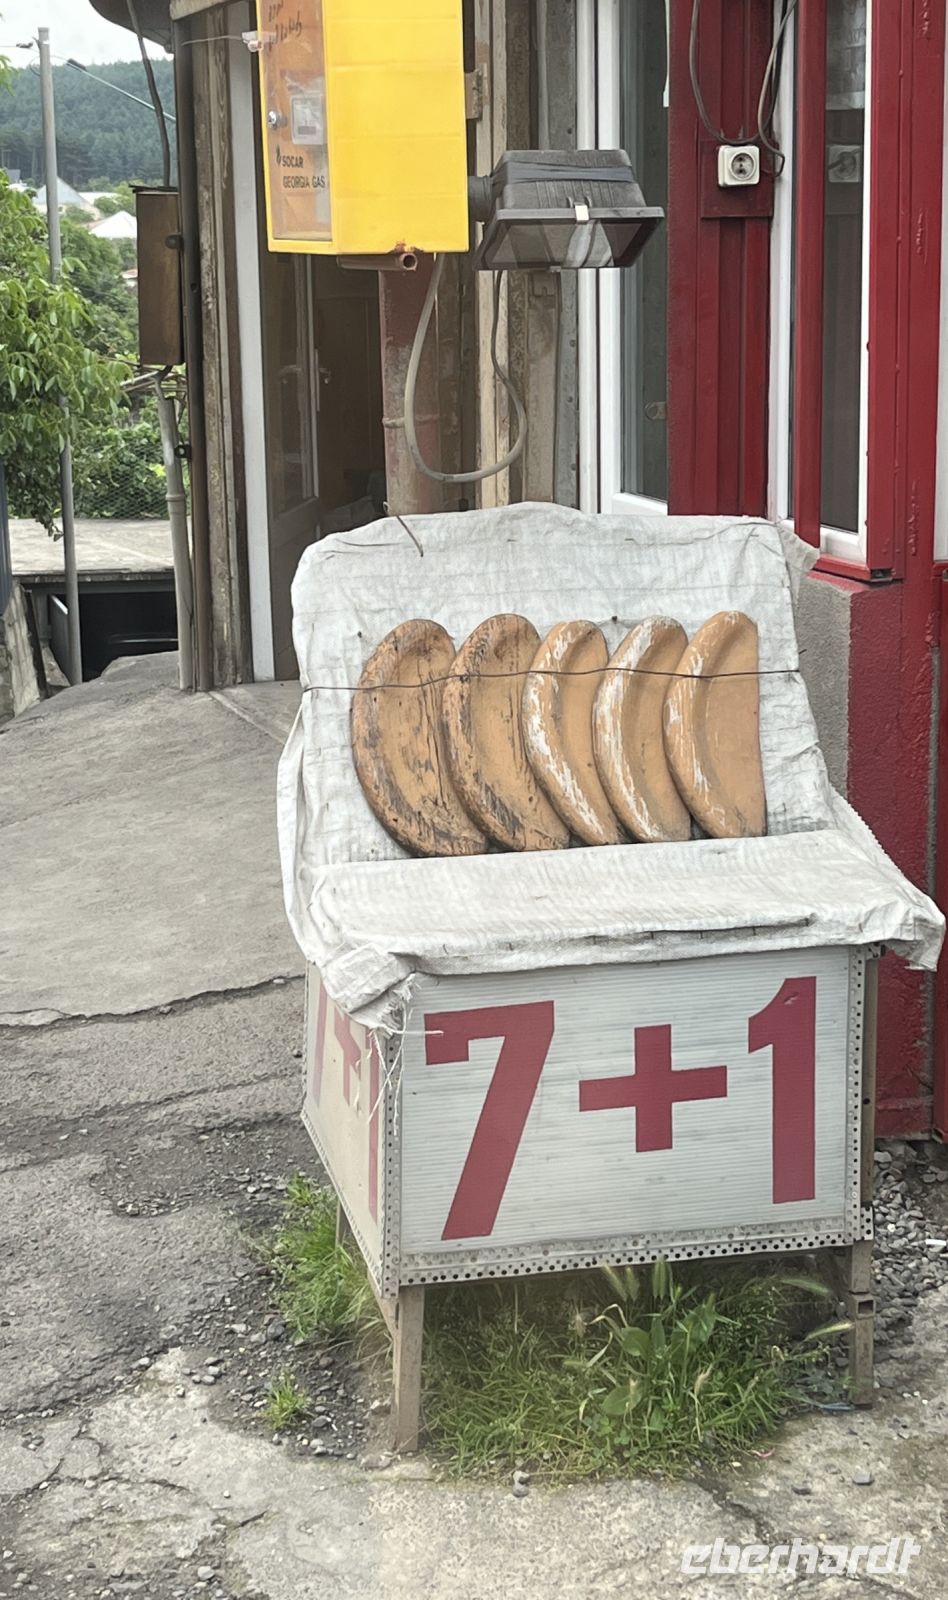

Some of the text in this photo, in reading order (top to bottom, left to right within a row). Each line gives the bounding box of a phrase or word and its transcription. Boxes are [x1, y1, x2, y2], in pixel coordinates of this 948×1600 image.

[282, 155, 304, 168] SOCAR
[282, 175, 325, 189] GEORGIA GAS
[424, 976, 816, 1241] 7+1
